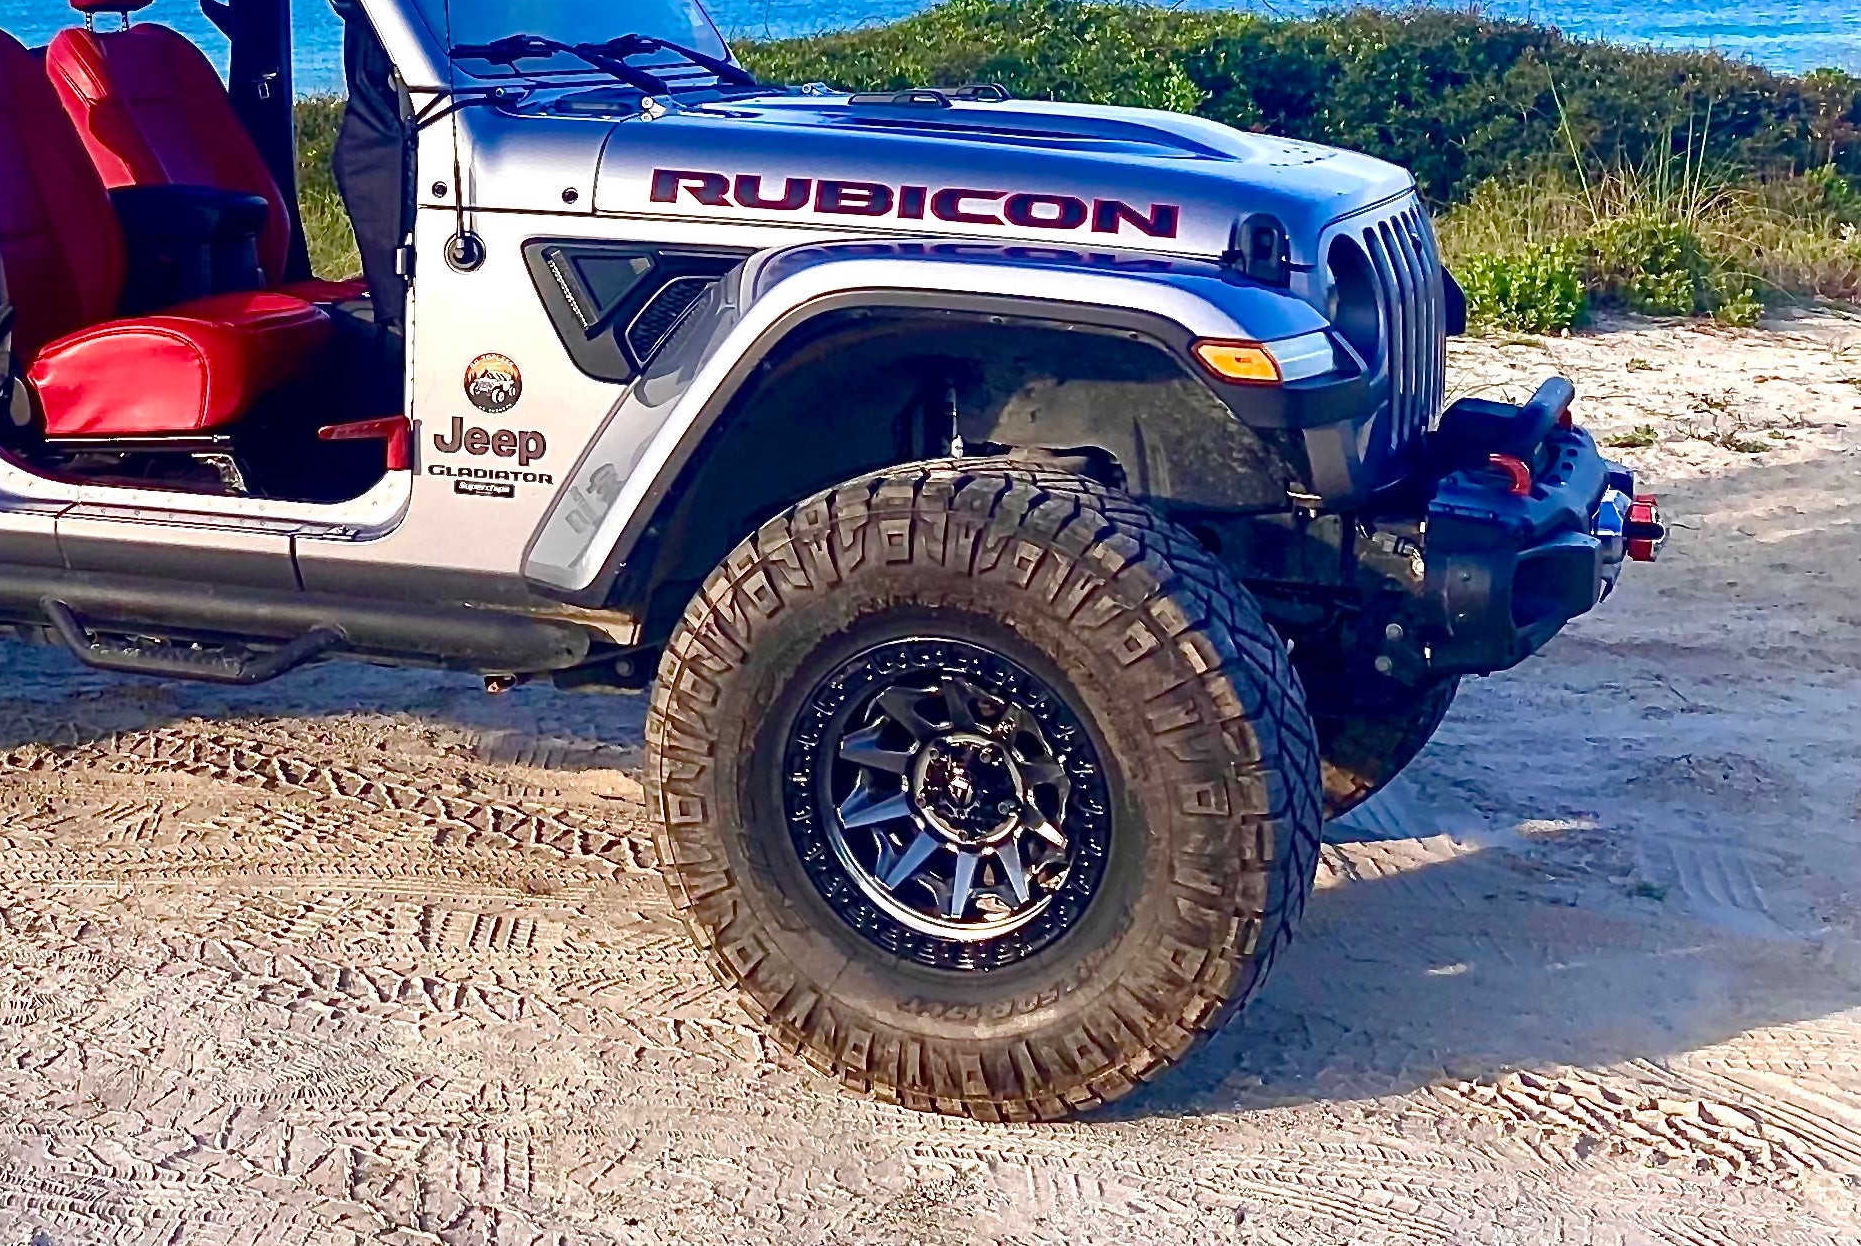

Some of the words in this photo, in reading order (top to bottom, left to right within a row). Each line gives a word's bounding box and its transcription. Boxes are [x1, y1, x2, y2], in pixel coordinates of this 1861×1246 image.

[649, 167, 1180, 239] RUBICON
[433, 415, 547, 466] Jeep
[427, 464, 554, 485] GLADIATOR
